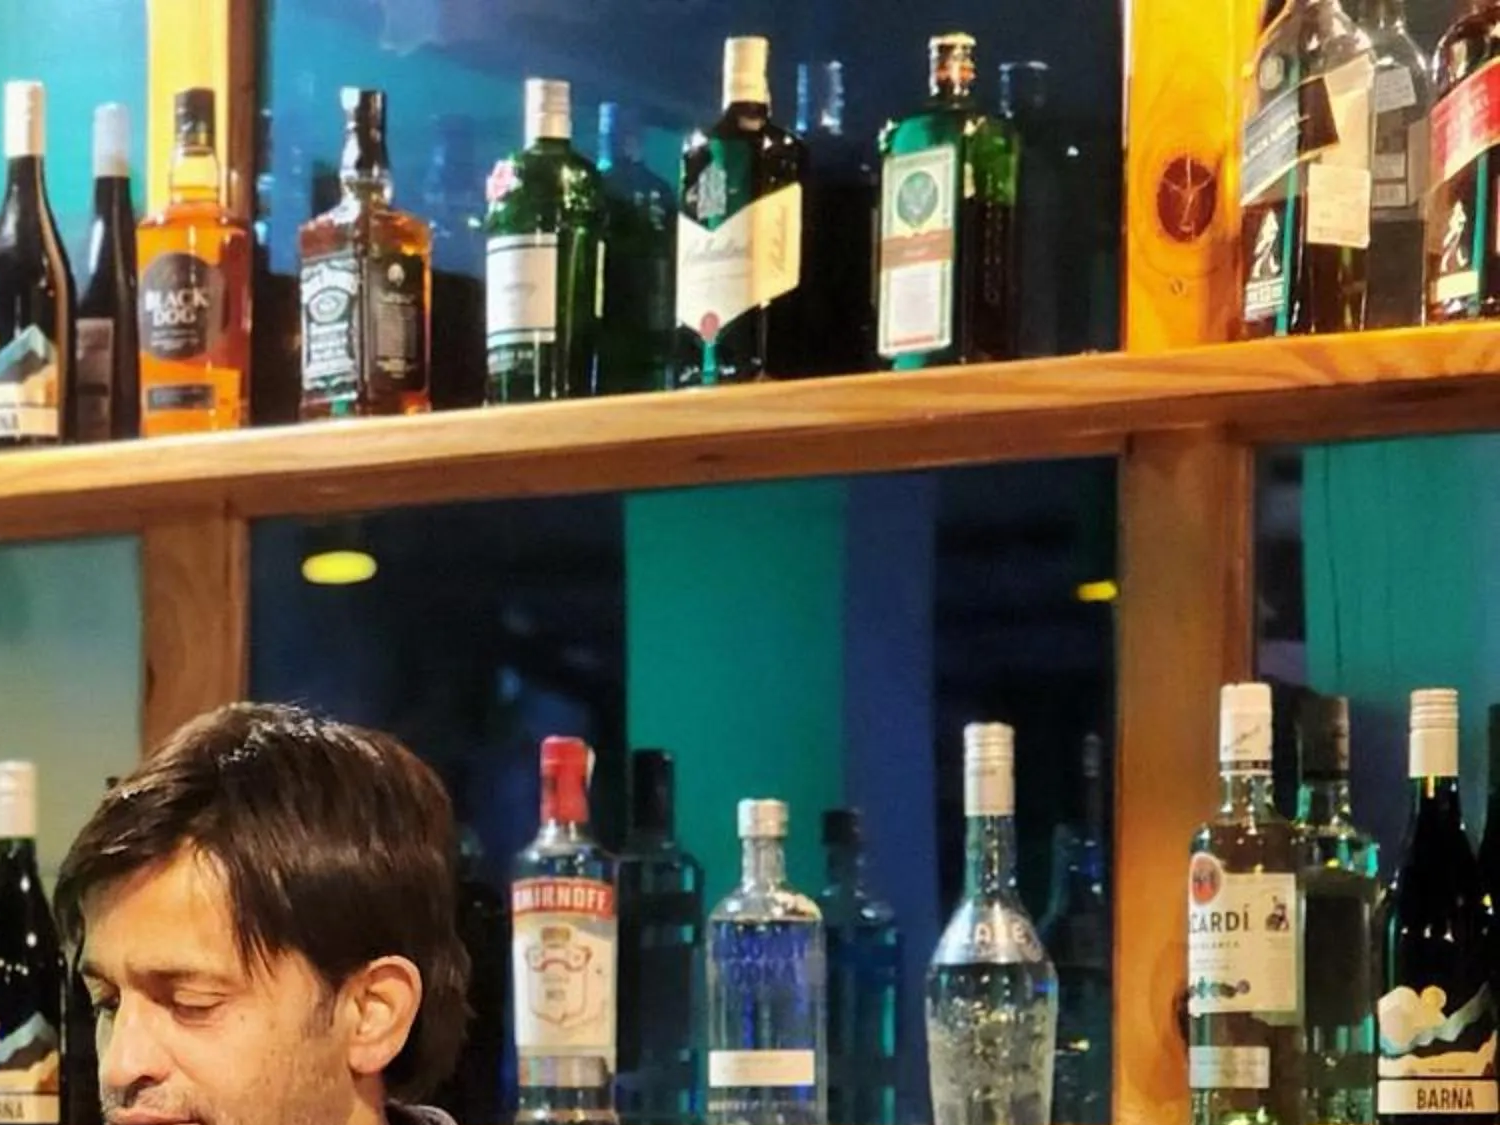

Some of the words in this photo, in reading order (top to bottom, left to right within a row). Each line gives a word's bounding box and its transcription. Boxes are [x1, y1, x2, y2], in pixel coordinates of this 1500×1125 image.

[153, 308, 197, 327] DOG
[1189, 903, 1250, 933] CARDÍ
[1416, 1086, 1475, 1110] BARNA
